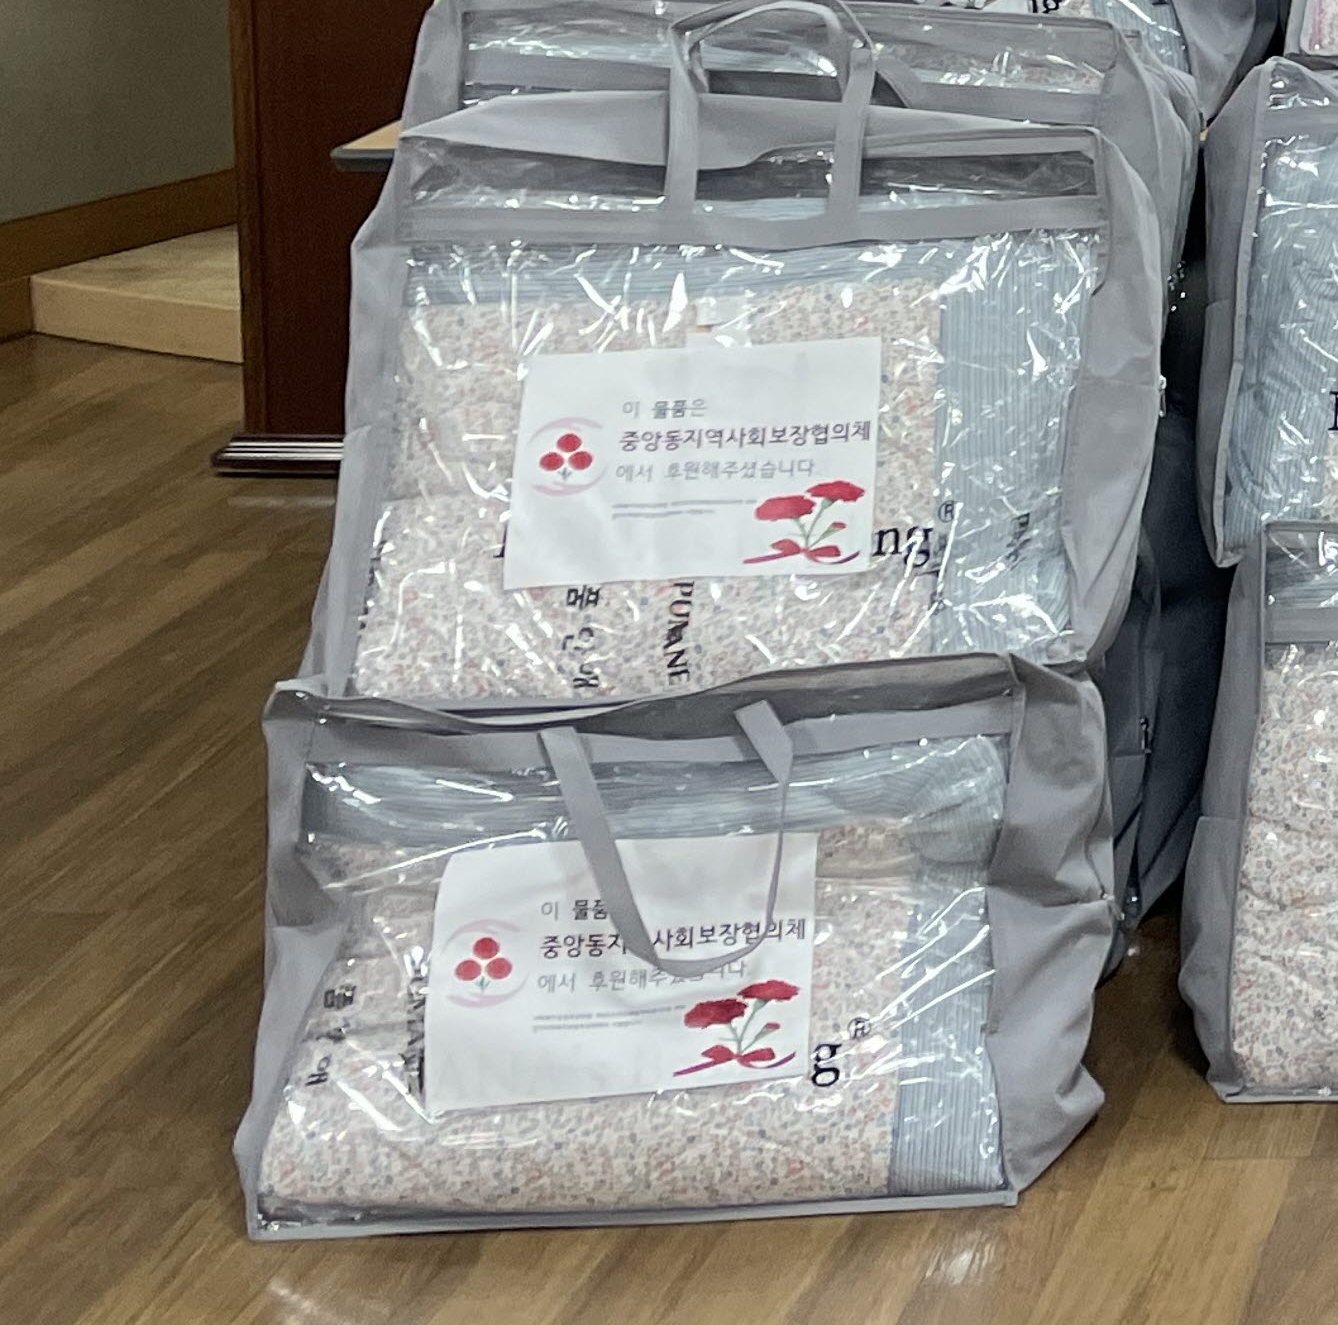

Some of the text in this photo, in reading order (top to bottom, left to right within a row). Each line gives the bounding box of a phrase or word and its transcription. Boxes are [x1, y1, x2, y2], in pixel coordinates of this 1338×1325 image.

[622, 398, 708, 420] 이 물품은
[619, 419, 872, 453] 중앙동지역사회보장협의체
[615, 463, 653, 483] 에서
[541, 901, 560, 922] 이
[540, 918, 807, 959] 중앙동지사회보장협의체
[538, 972, 576, 994] 에서
